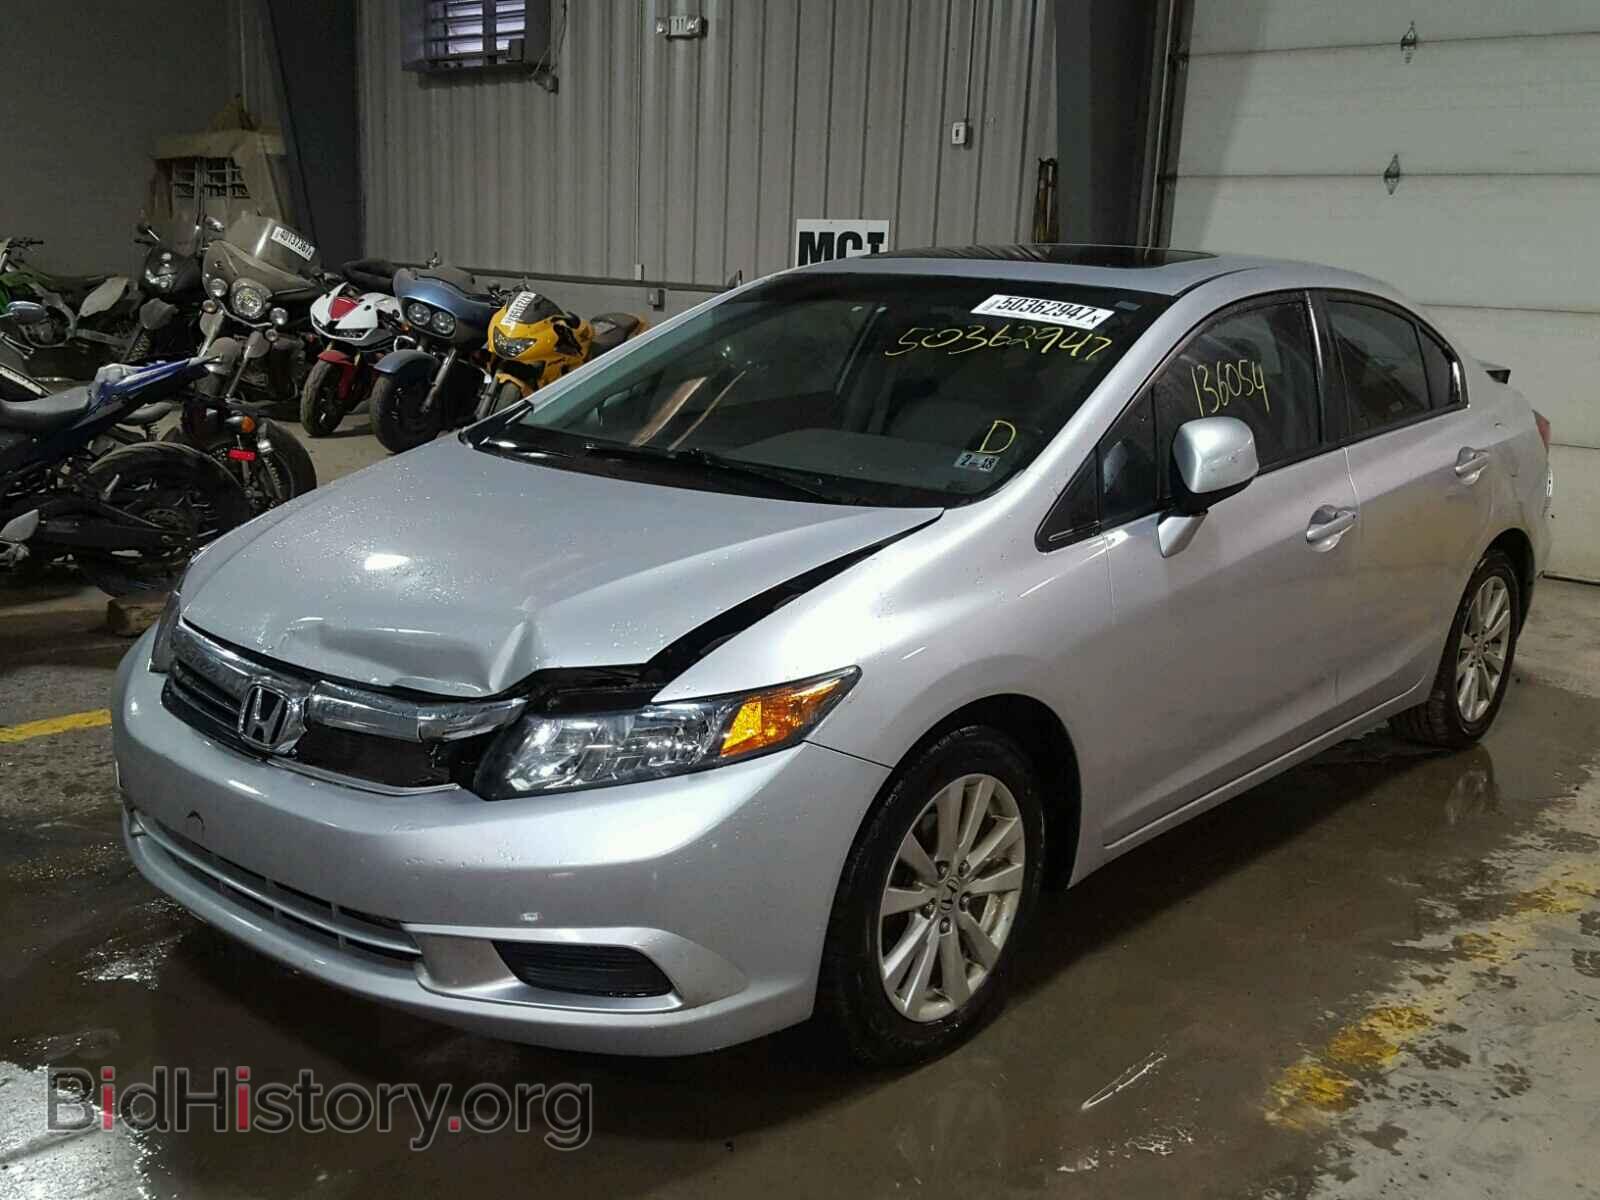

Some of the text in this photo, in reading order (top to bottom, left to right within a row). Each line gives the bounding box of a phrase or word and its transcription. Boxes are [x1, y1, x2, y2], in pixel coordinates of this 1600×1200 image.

[885, 324, 1112, 360] 50362947
[1191, 360, 1270, 416] 136054
[976, 420, 1016, 453] D
